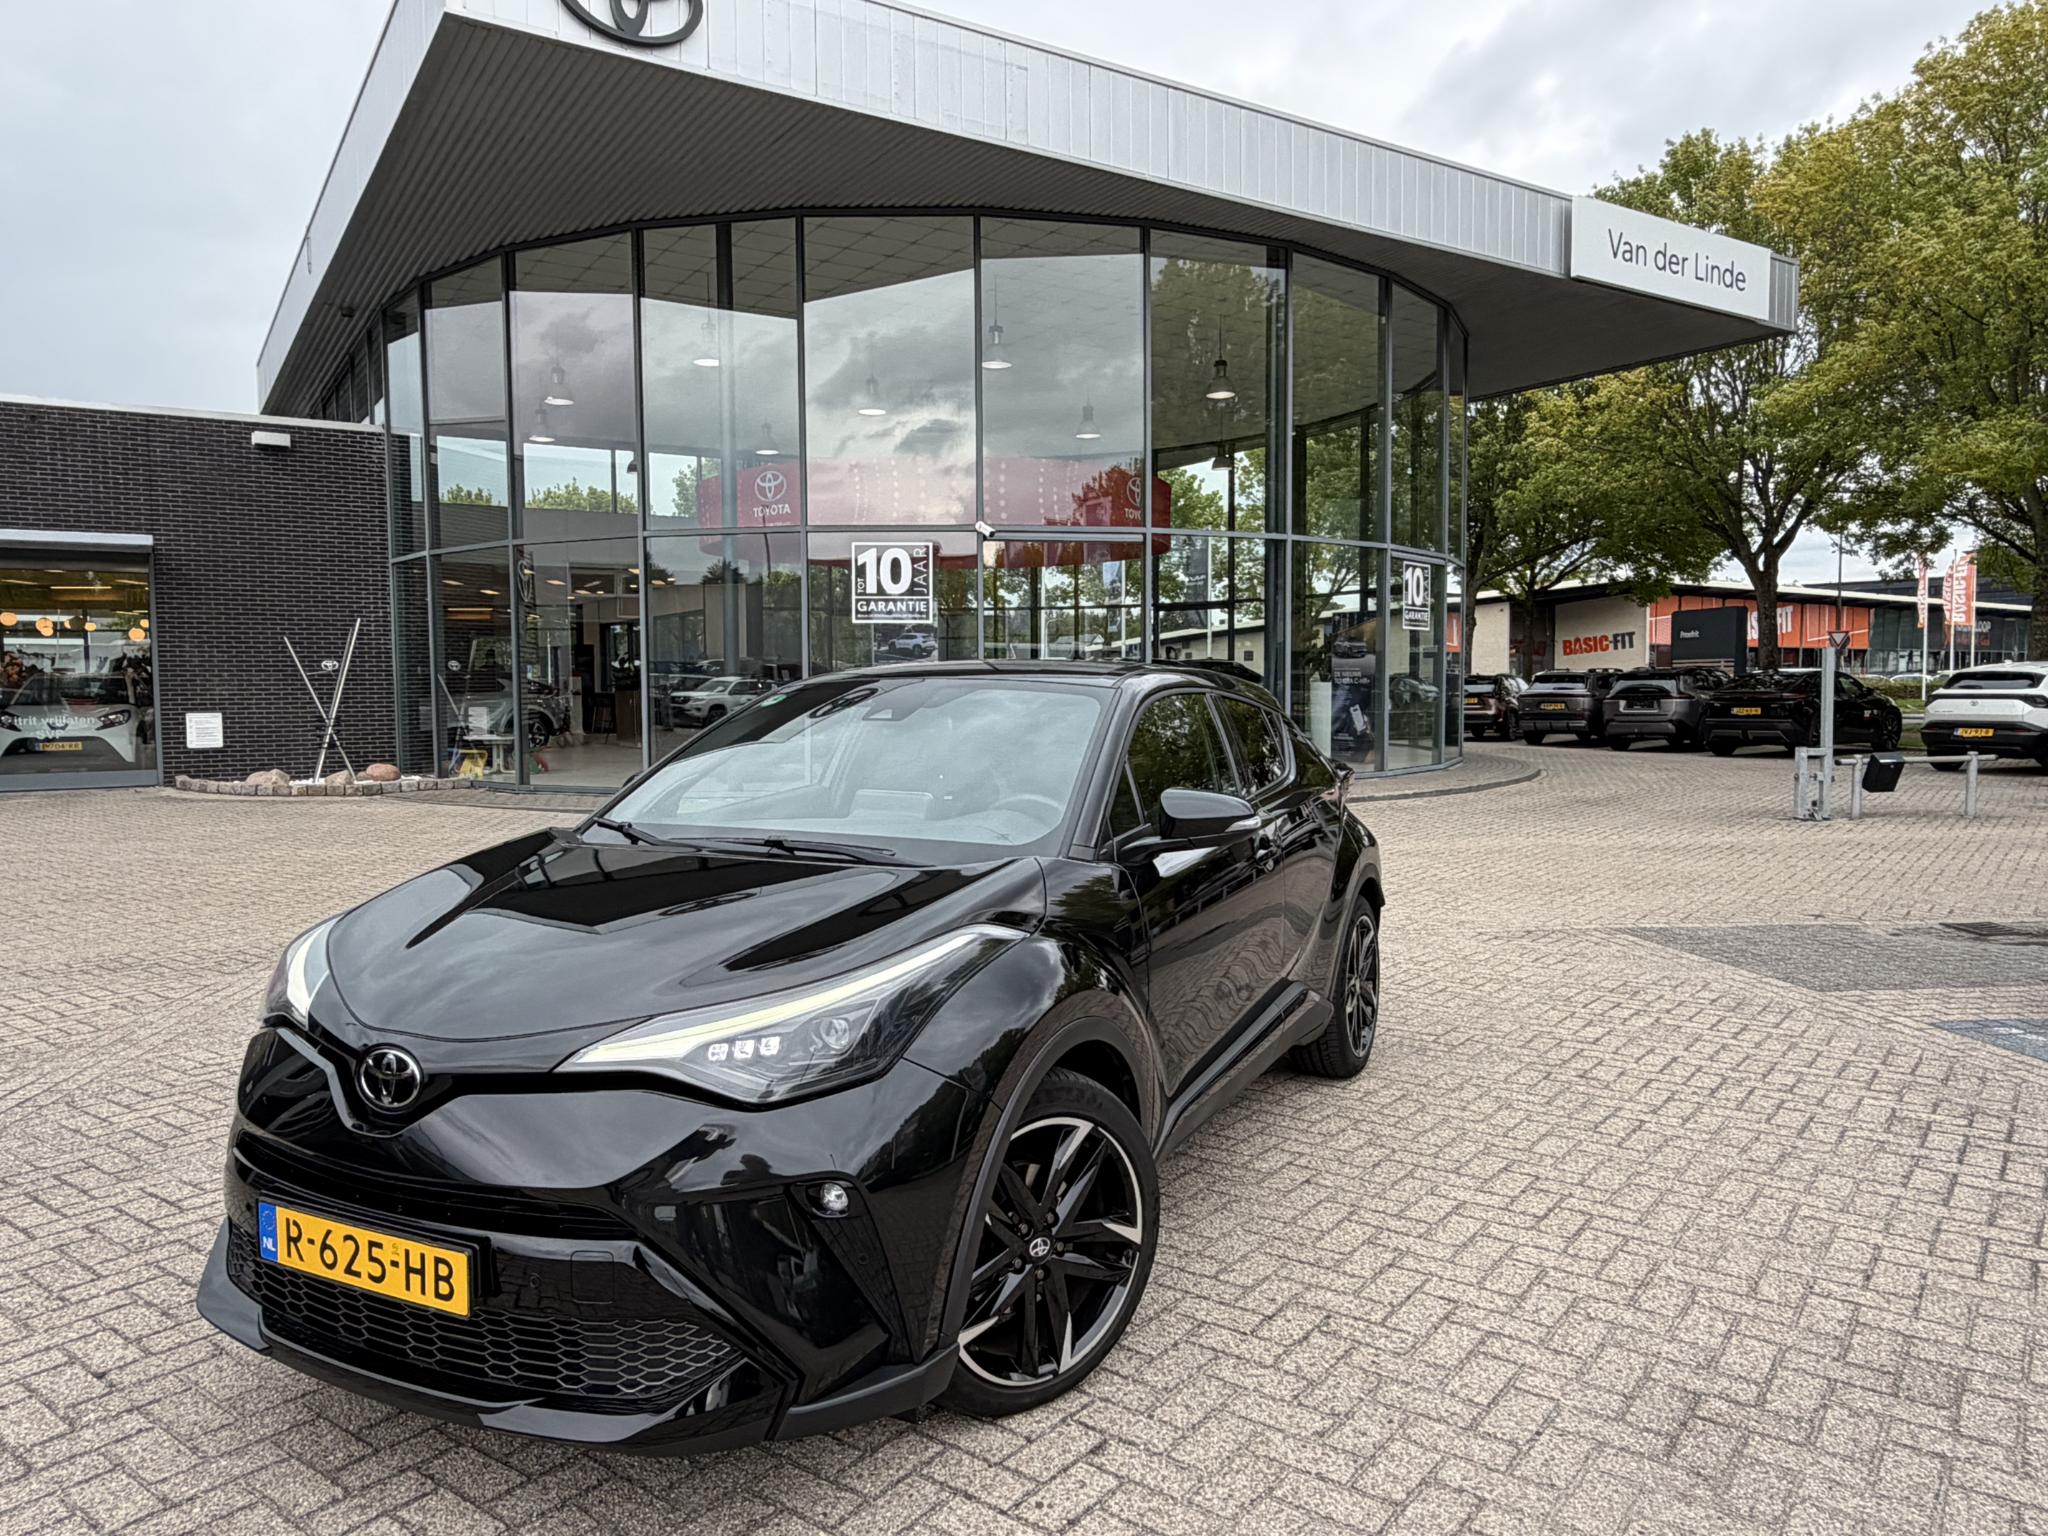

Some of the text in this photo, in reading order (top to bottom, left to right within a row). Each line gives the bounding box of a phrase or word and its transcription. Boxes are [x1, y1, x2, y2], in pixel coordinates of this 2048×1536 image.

[1608, 228, 1746, 291] Van der Linde
[753, 504, 791, 517] TOYOTA
[857, 547, 912, 594] 10
[913, 546, 927, 594] JAAR
[1405, 566, 1424, 606] 10
[857, 601, 927, 612] GARANTIE
[1404, 610, 1429, 621] GARANTIE
[1562, 632, 1636, 656] BASIC-FIT
[13, 716, 37, 727] itrit
[263, 1236, 276, 1251] NL
[285, 1217, 455, 1302] R-625-HB
